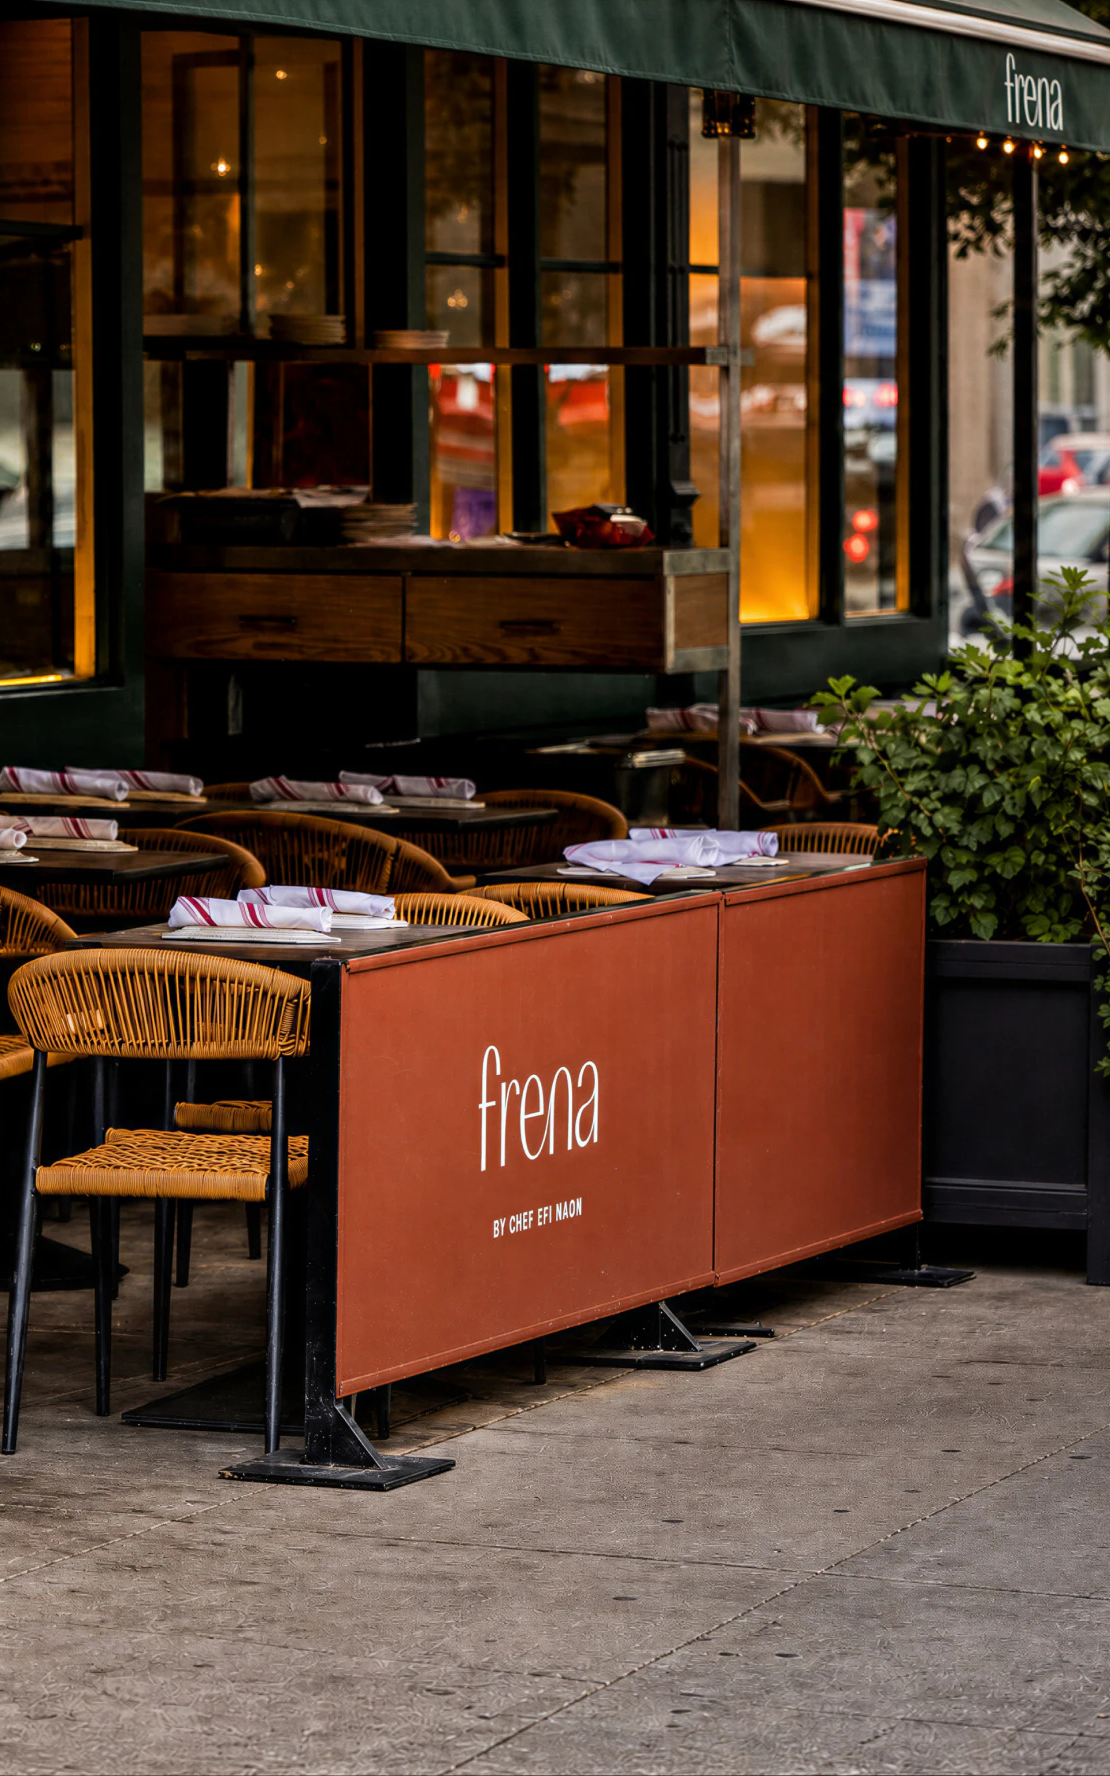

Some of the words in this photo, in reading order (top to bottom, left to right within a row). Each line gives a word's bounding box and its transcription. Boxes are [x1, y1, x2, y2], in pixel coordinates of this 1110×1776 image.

[1004, 52, 1063, 131] frena
[478, 1045, 599, 1171] frena
[493, 1218, 507, 1239] BY
[509, 1209, 534, 1234] CHEF
[537, 1205, 553, 1227] EFI
[555, 1197, 583, 1222] NAON
